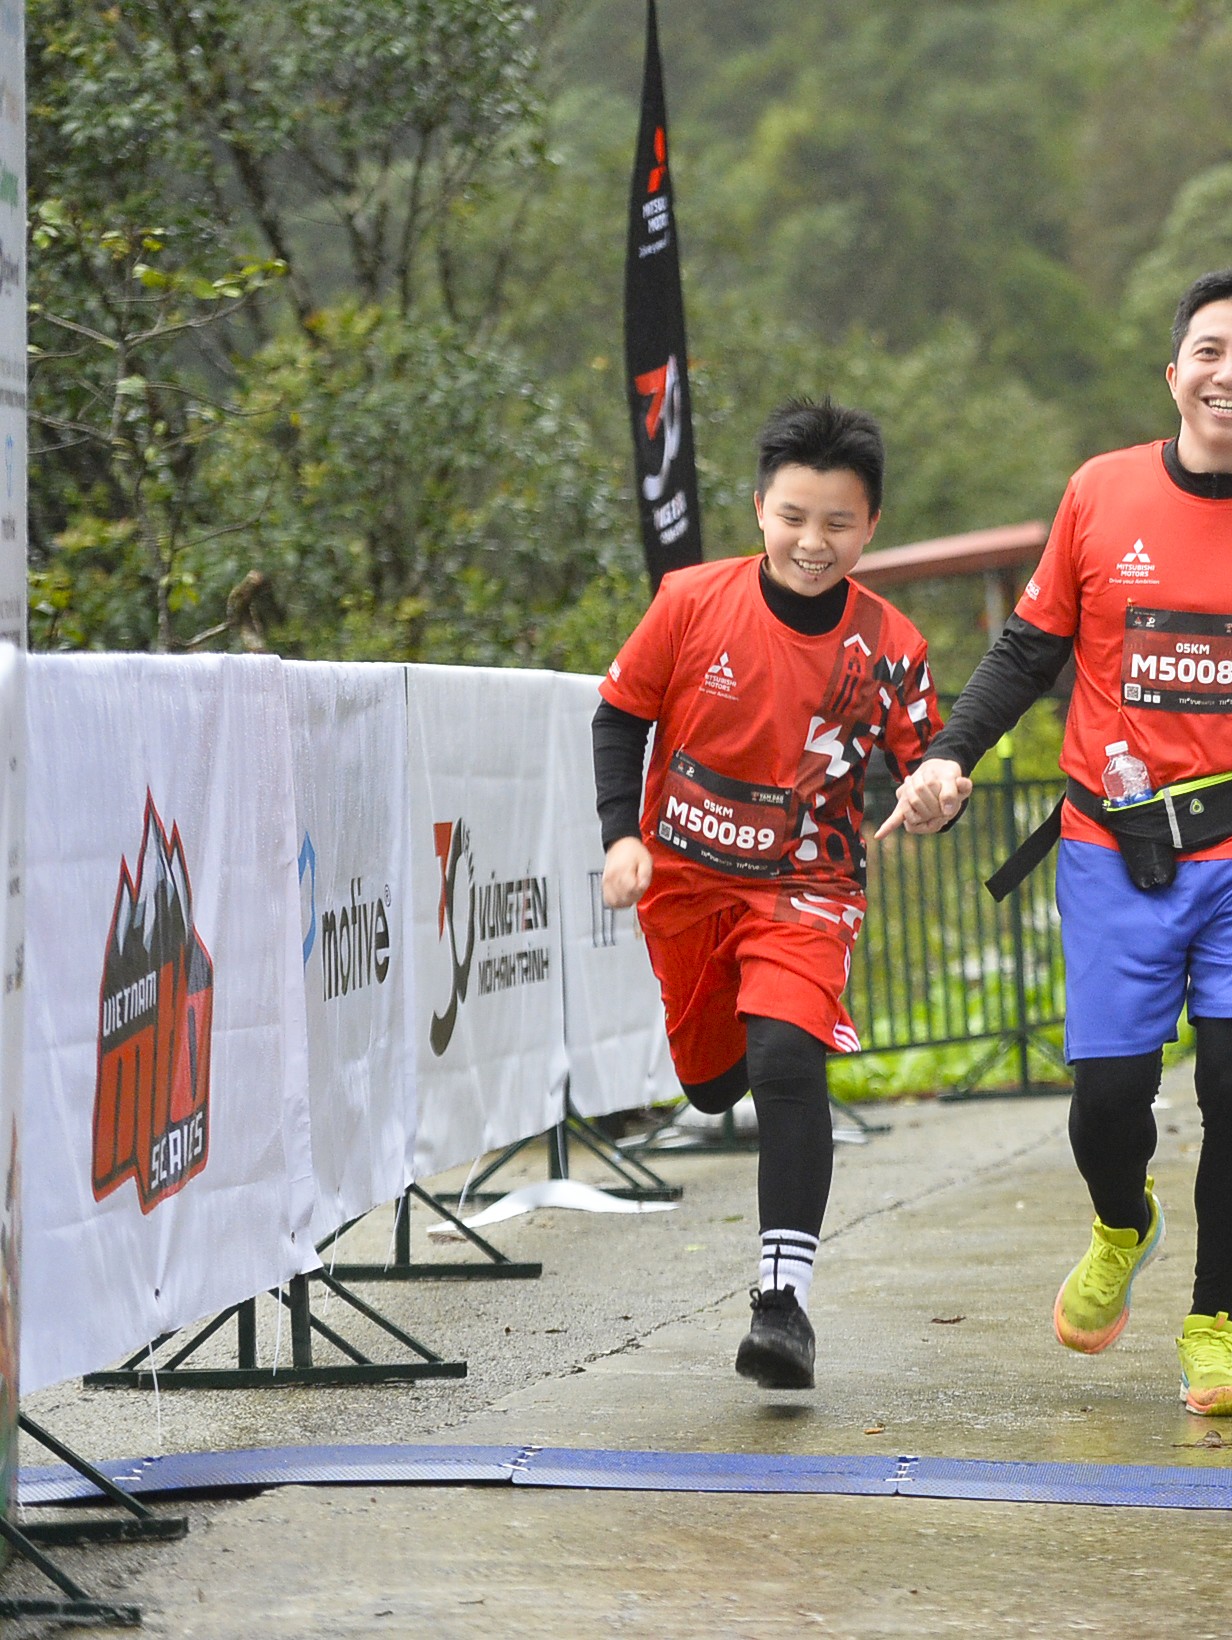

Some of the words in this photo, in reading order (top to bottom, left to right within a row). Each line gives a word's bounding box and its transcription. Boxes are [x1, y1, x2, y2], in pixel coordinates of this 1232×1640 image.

[1116, 563, 1155, 571] MITSUBISHI
[1176, 642, 1210, 655] 05KM
[703, 799, 734, 818] 05KM
[666, 795, 775, 851] M50089
